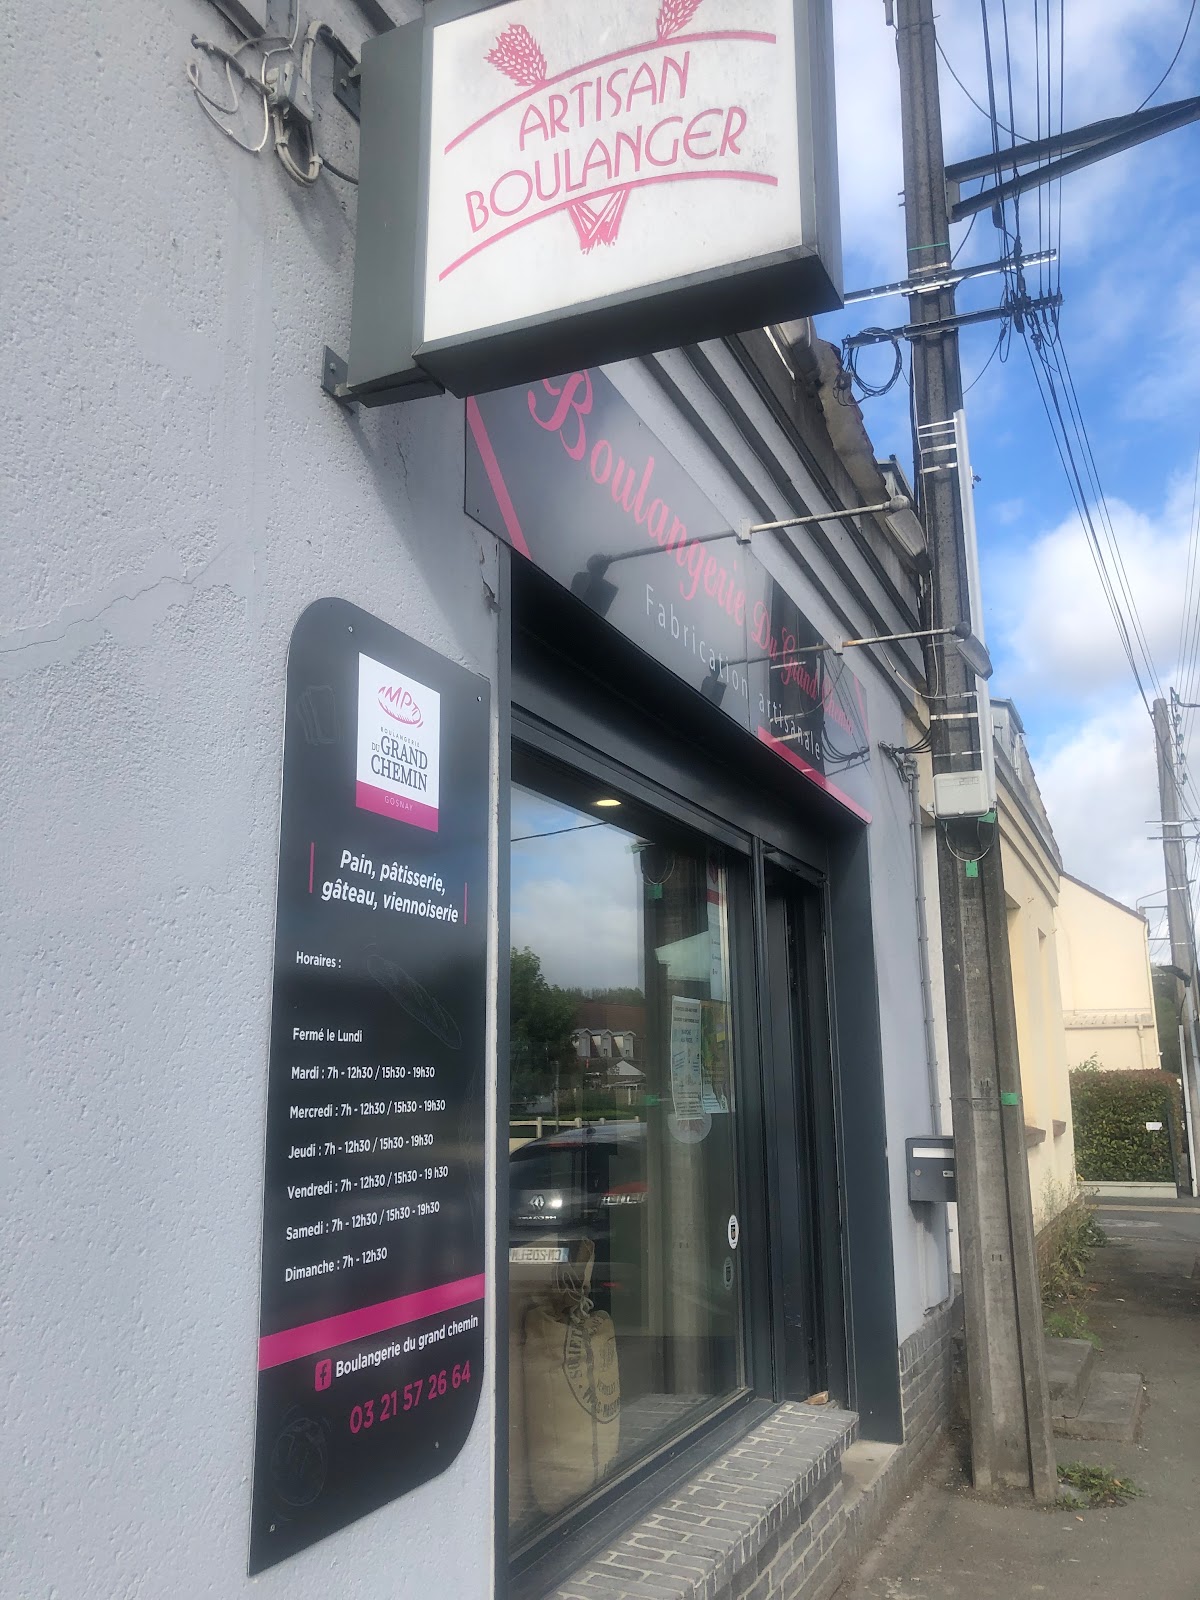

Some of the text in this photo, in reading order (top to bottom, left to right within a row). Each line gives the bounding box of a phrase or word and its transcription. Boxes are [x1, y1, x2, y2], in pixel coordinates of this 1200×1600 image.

[519, 51, 690, 150] ARTISAN
[465, 106, 747, 233] BOULANGER
[528, 369, 744, 627] Boulangerie
[645, 584, 820, 760] Fabrication artisanale
[371, 735, 428, 769] DU GRAND
[380, 726, 420, 748] BOULANGERIE
[370, 754, 427, 792] CHEMIN
[384, 795, 413, 812] GOSNAY
[339, 849, 446, 895] Pain, pâtisserie,
[320, 880, 459, 923] gâteau, viennoiserie
[296, 951, 336, 968] Horaires
[292, 1028, 363, 1042] Fermé le Lundi
[291, 1067, 319, 1080] Mardi
[327, 1067, 339, 1079] 7h
[347, 1066, 373, 1079] 12h30
[382, 1067, 406, 1078] 15h30
[413, 1066, 435, 1078] 19h30
[290, 1104, 333, 1119] Mercredi
[340, 1104, 352, 1116] 7h
[360, 1102, 385, 1115] 12h30
[394, 1101, 417, 1113] 15h30
[424, 1100, 446, 1111] 19h30
[288, 1144, 316, 1159] Jeudi
[324, 1143, 336, 1155] 7h
[344, 1139, 371, 1154] 12h30
[380, 1136, 404, 1150] 15h30
[411, 1133, 434, 1147] 19h30
[287, 1180, 333, 1200] Vendredi
[340, 1179, 352, 1192] 7h
[360, 1174, 386, 1189] 12h30
[394, 1171, 418, 1185] 15h30
[425, 1168, 433, 1180] 19
[434, 1165, 449, 1179] h30
[286, 1221, 324, 1241] Samedi
[331, 1219, 343, 1232] 7h
[351, 1212, 378, 1229] 12h30
[386, 1206, 411, 1222] 15h30
[417, 1201, 440, 1217] 19h30
[285, 1260, 335, 1283] Dimanche
[342, 1255, 354, 1269] 7h
[361, 1248, 388, 1266] 12h30
[335, 1345, 401, 1378] Boulangerie
[403, 1337, 416, 1352] du
[418, 1325, 446, 1350] grand
[447, 1315, 479, 1337] chemin
[350, 1360, 471, 1434] 03 21 57 26 64
